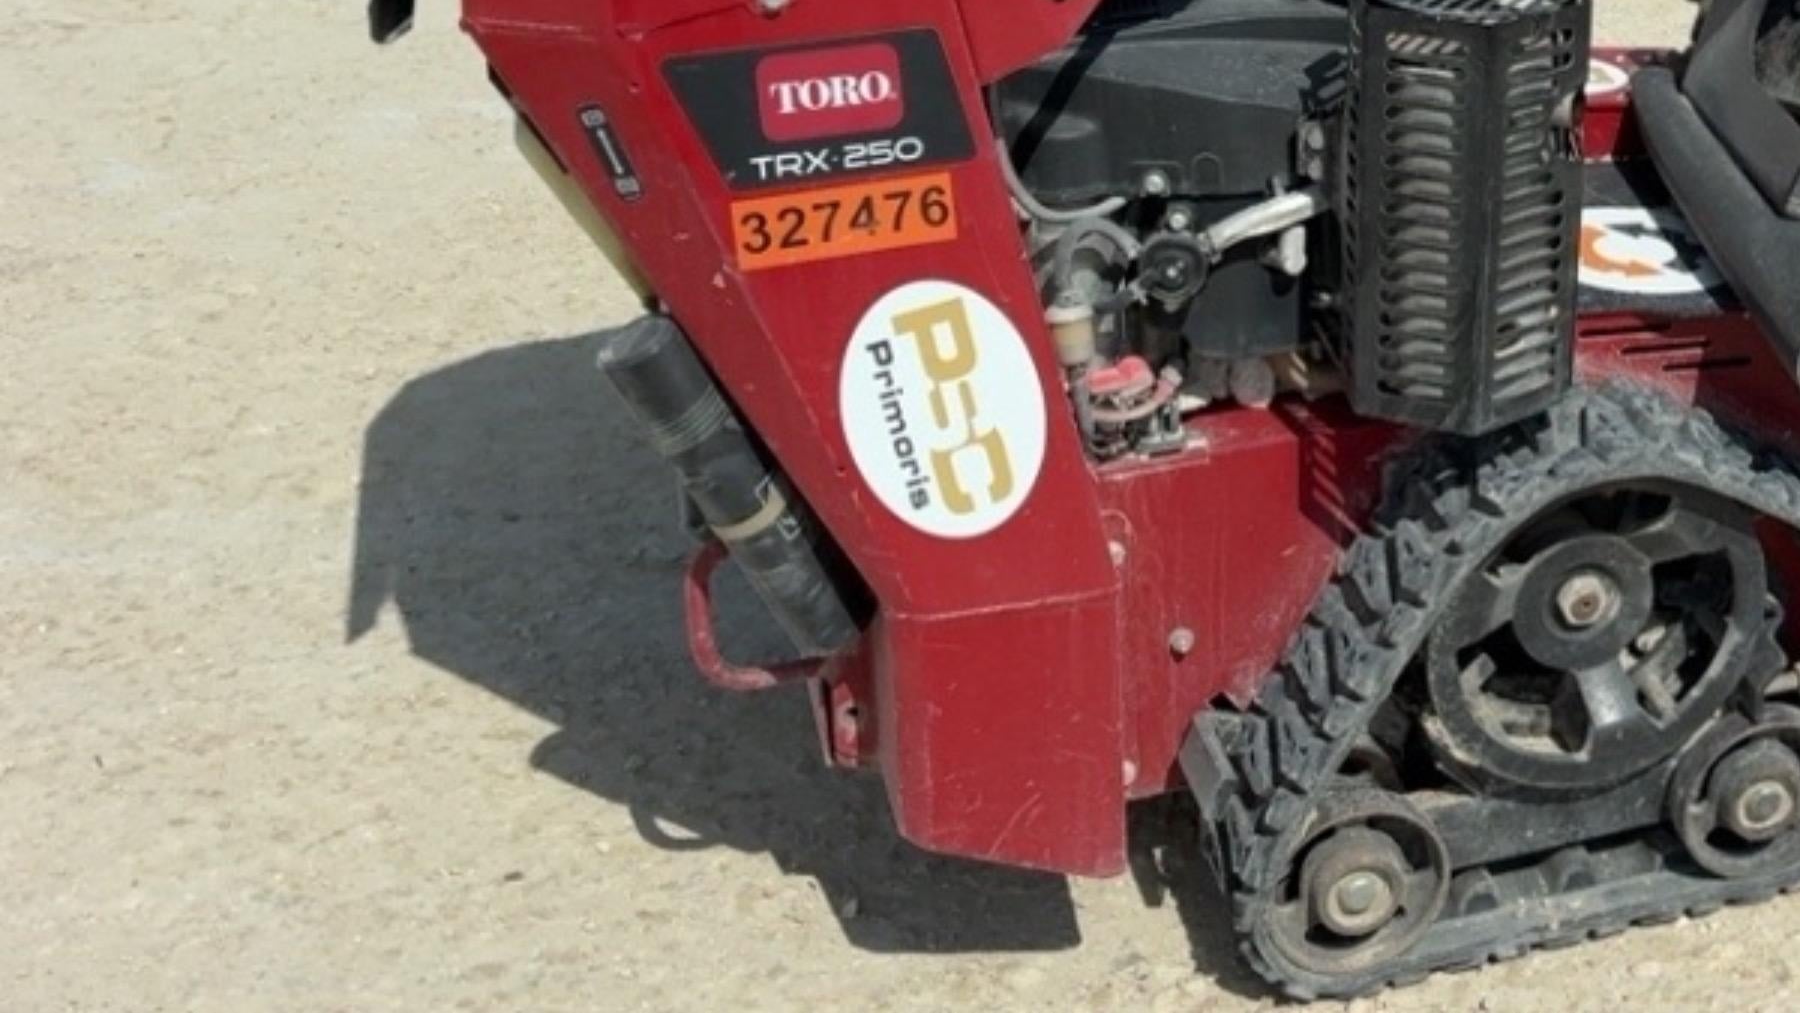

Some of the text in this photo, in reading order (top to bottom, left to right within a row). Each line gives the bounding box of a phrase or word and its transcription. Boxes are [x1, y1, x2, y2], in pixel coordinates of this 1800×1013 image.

[769, 71, 889, 115] TORO
[738, 185, 950, 255] 327476
[864, 339, 928, 512] Primoris
